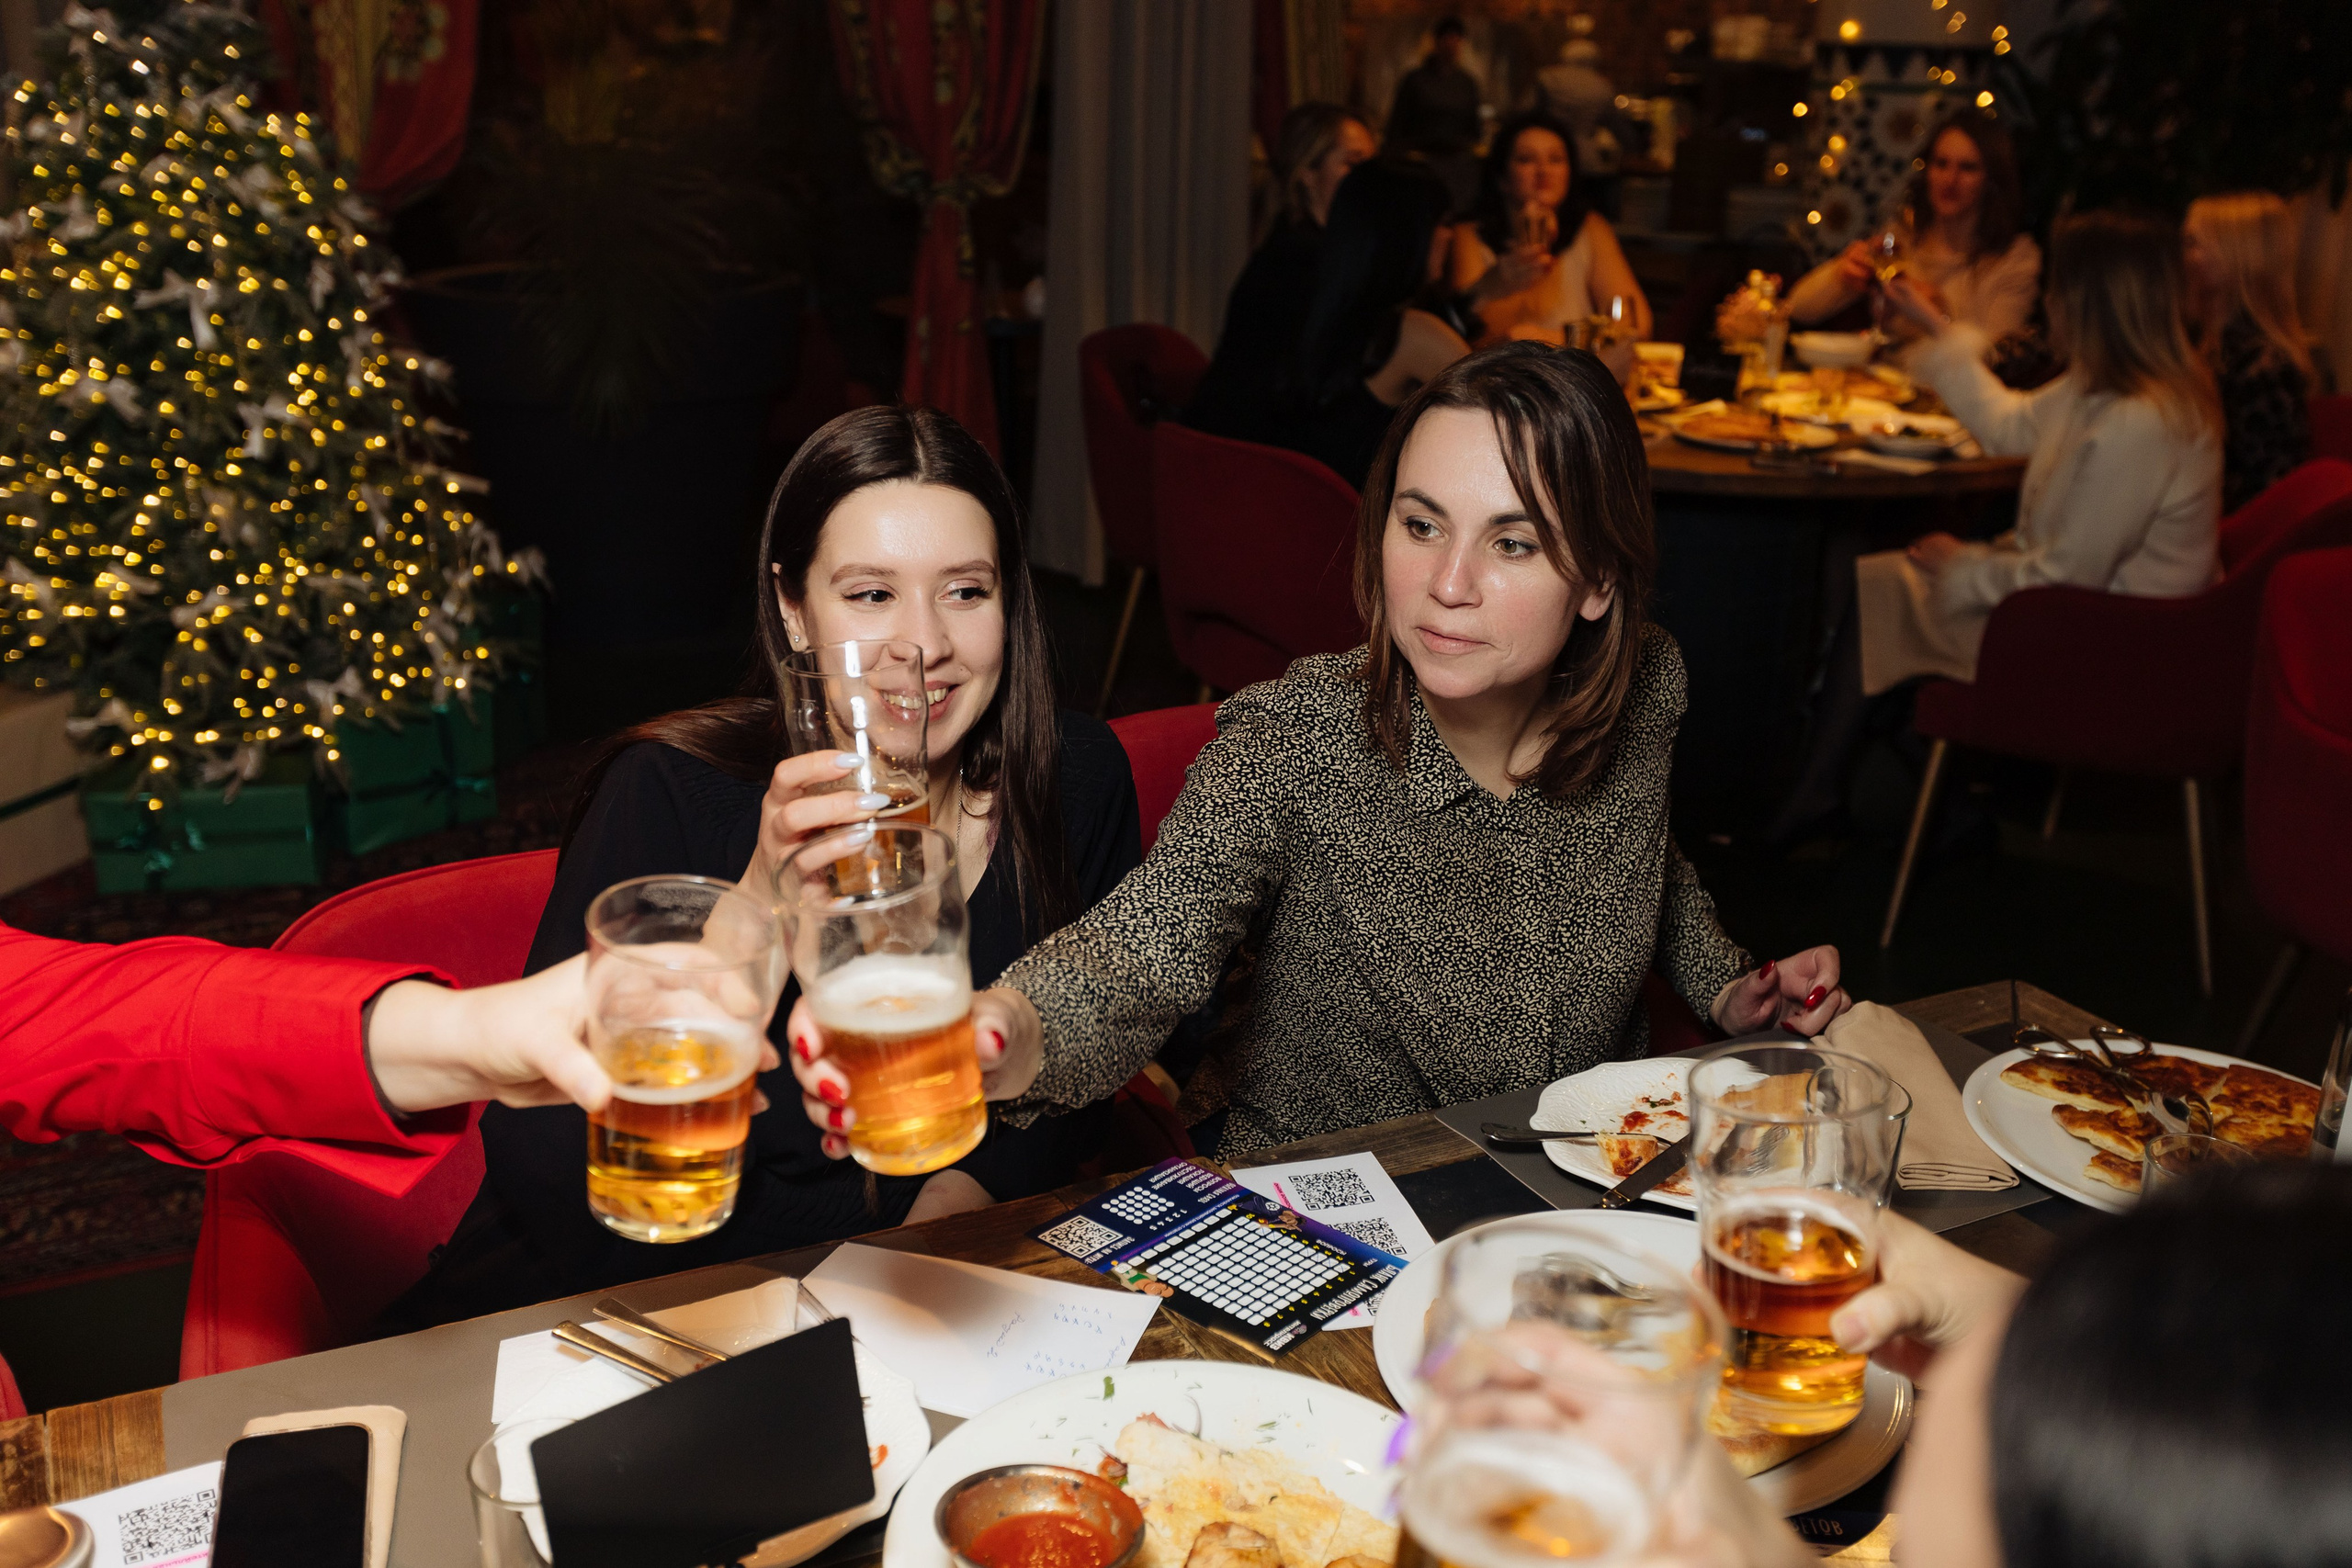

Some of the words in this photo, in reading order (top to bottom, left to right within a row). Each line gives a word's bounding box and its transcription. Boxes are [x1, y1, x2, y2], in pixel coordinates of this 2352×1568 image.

[1148, 1162, 1187, 1183] ОРГАНИЗАЦИЯ
[1151, 1166, 1196, 1190] ОБСЛУЖИВАНИЕ
[1177, 1168, 1204, 1185] ЛОКАЦИЯ
[1185, 1172, 1214, 1189] ВЕДУЩИЙ
[1193, 1176, 1223, 1193] ВОПРОСЫ
[1109, 1236, 1136, 1250] ЗАПИСЬ
[1316, 1239, 1347, 1256] ВОПРОСЫ
[1363, 1258, 1378, 1267] ТУРЫ
[1370, 1263, 1402, 1284] БЛАНК
[1310, 1279, 1378, 1321] САМОПРОВЕРКИ
[1269, 1332, 1295, 1350] КВИЗ
